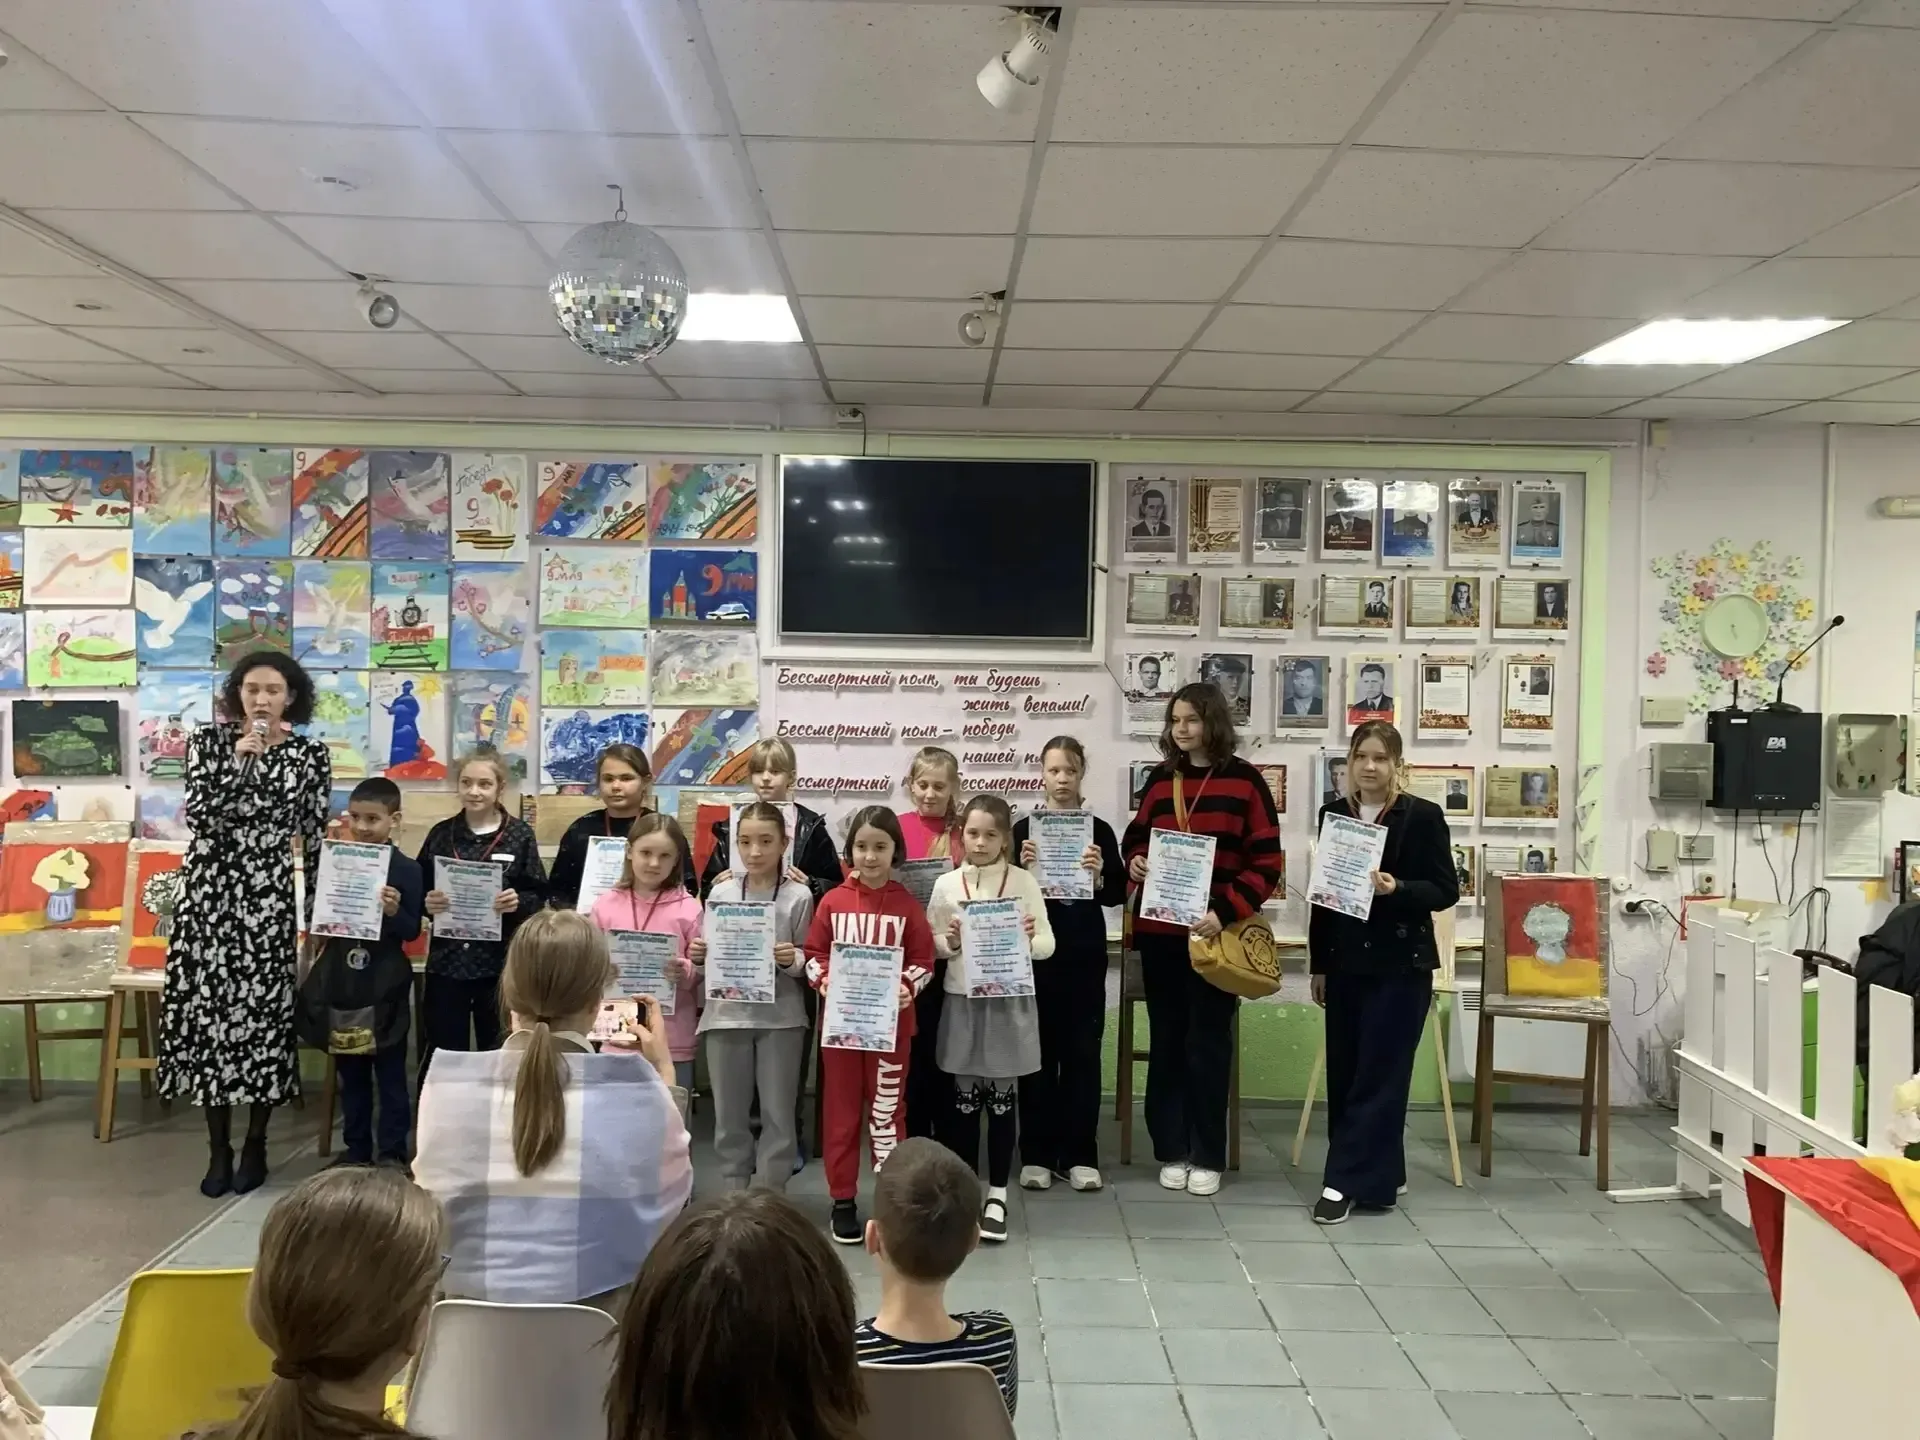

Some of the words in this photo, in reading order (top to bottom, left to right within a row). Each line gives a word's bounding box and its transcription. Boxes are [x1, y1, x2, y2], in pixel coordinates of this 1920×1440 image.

[466, 498, 480, 520] 9
[701, 563, 724, 597] 9
[777, 667, 892, 690] Бессмертный
[898, 672, 939, 687] полк,
[954, 674, 978, 686] ты
[986, 668, 1041, 693] будешь
[961, 699, 1010, 711] жить
[1023, 694, 1089, 713] веками!
[776, 719, 892, 742] Бессмертный
[962, 717, 1015, 741] победы
[962, 748, 1016, 763] нашей
[796, 774, 891, 795] ссмертный
